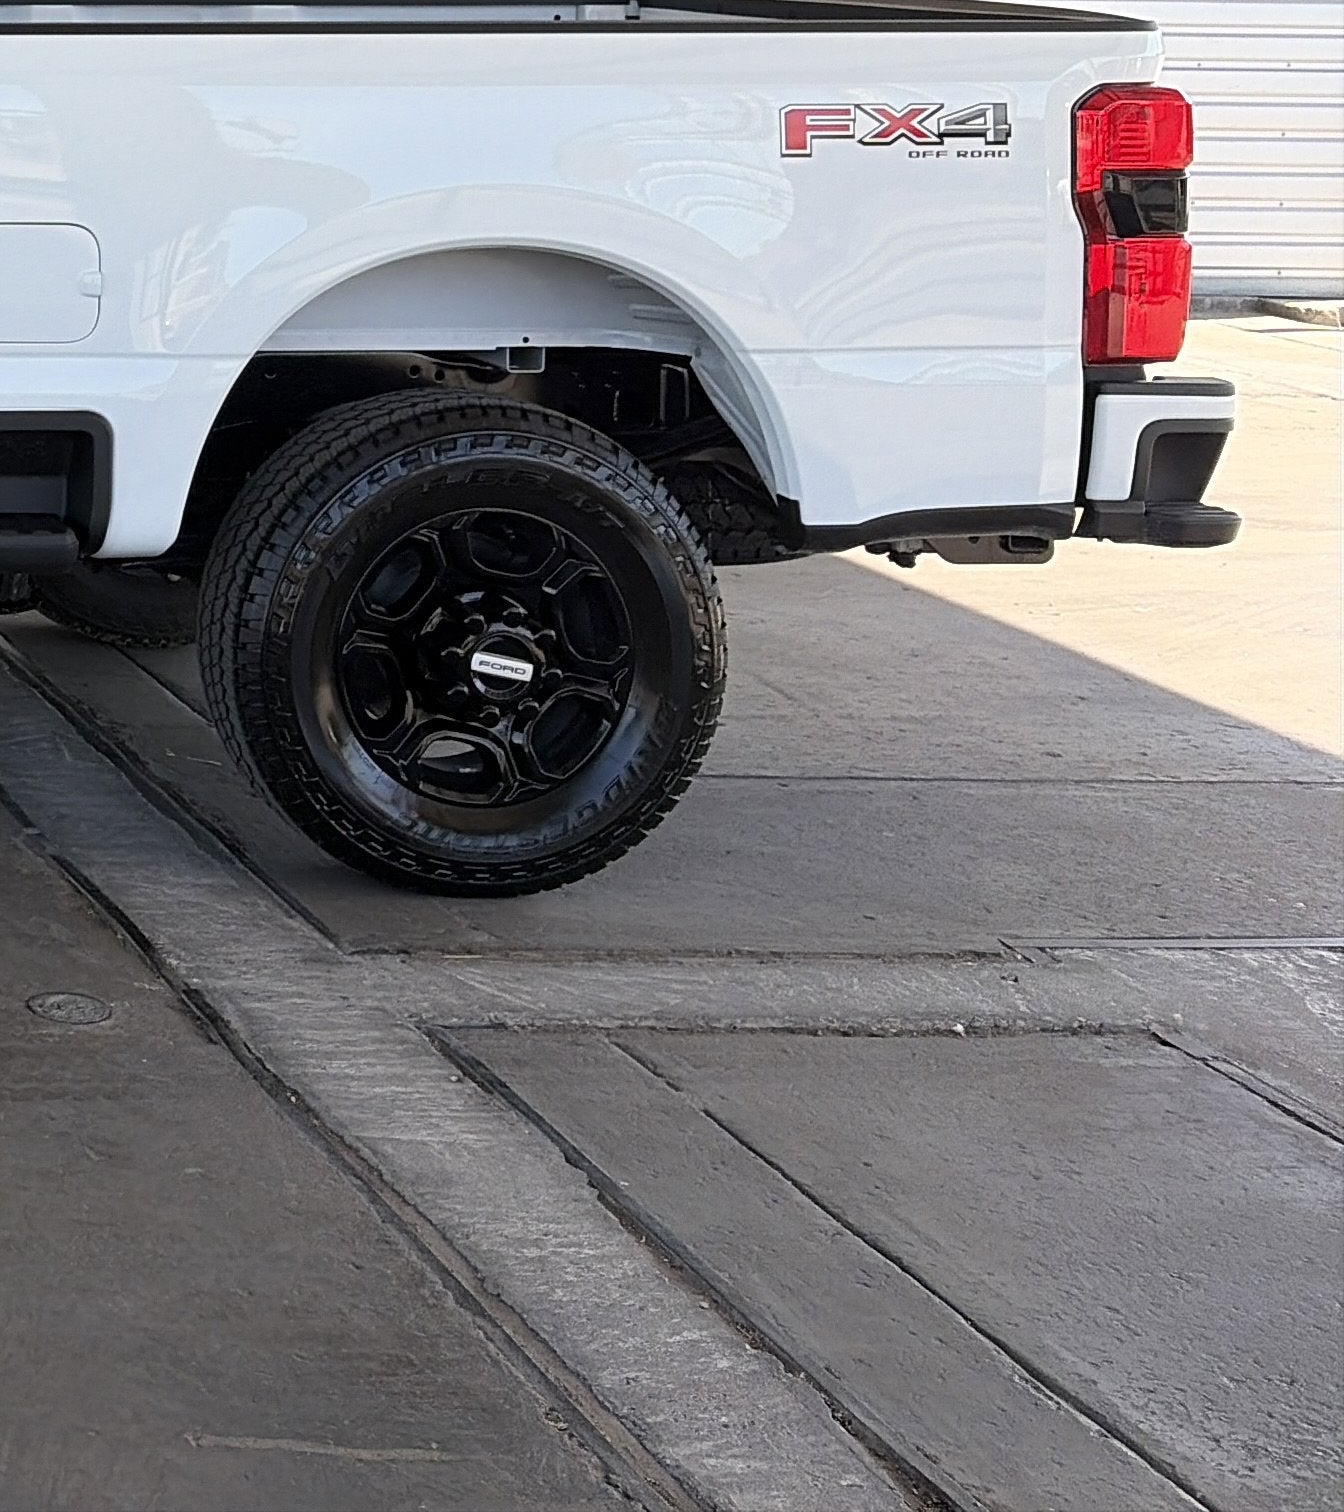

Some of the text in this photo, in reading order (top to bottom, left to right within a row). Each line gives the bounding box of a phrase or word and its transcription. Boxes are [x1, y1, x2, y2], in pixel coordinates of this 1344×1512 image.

[779, 103, 1012, 158] FX4
[908, 150, 1010, 159] OFF ROAD
[478, 660, 526, 675] FORD
